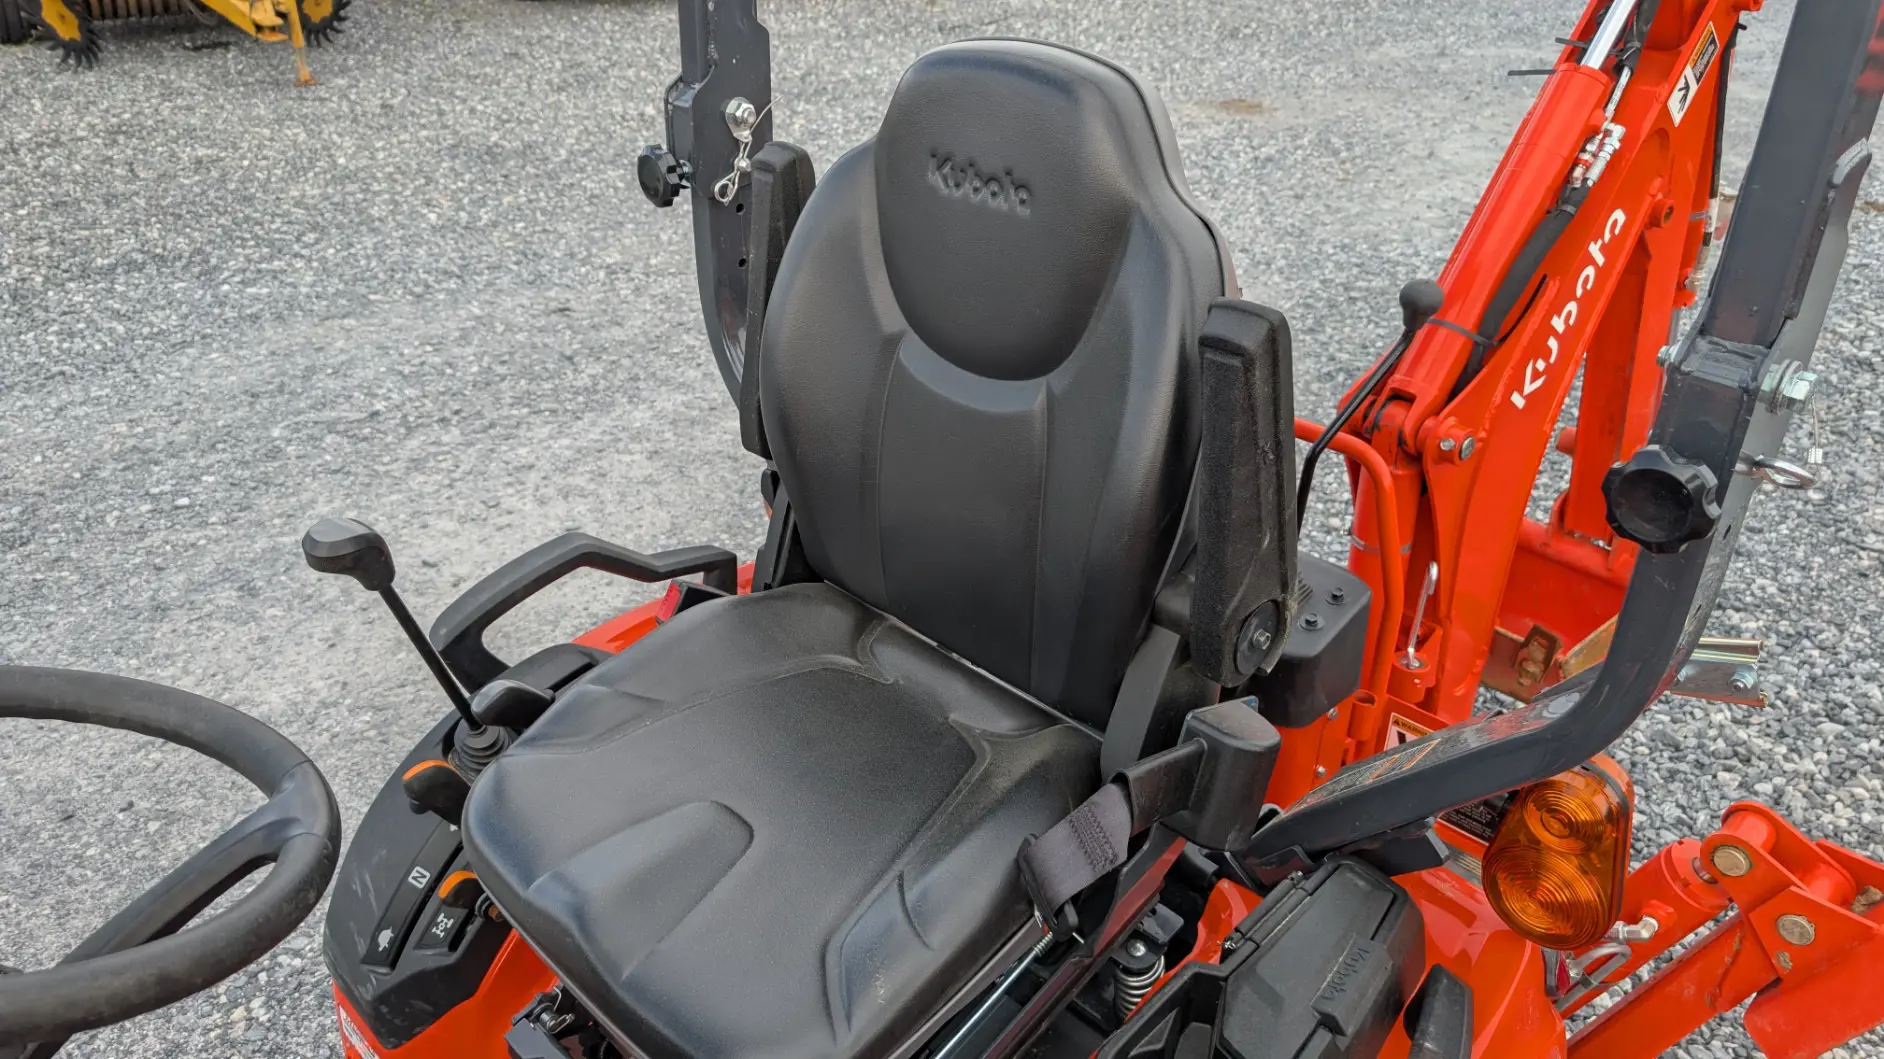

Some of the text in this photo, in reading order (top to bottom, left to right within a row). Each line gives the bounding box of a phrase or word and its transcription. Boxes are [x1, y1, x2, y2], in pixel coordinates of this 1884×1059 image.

[927, 150, 1032, 216] Kubota
[1510, 208, 1626, 409] Kubota
[410, 868, 429, 887] N
[1320, 947, 1370, 1000] Kubota
